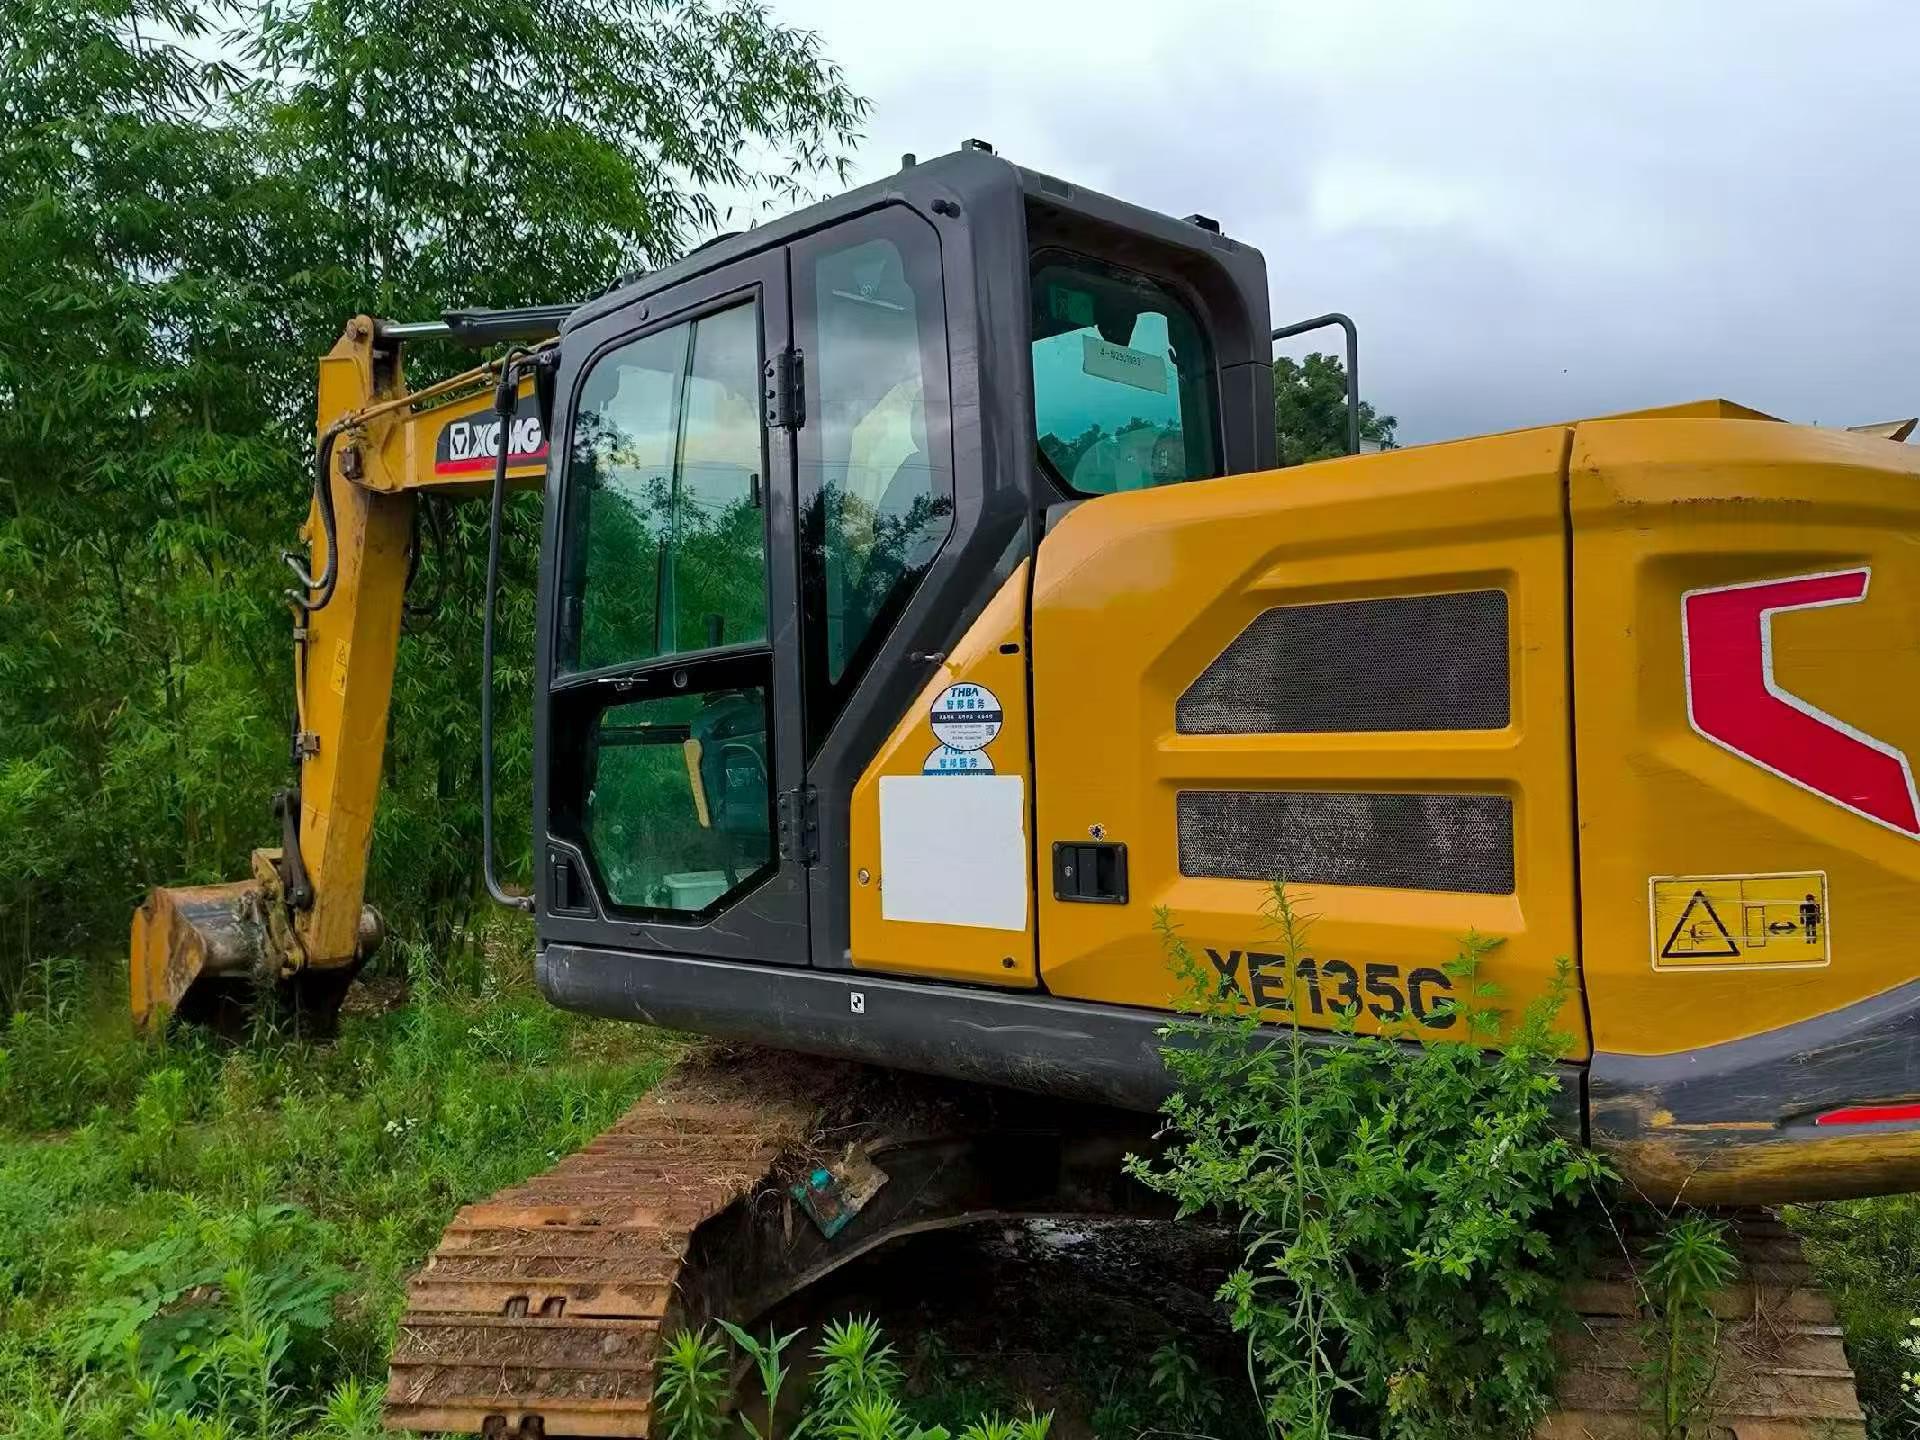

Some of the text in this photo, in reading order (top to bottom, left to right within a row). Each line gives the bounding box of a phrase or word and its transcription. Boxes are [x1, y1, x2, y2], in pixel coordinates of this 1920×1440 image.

[469, 417, 542, 459] XCMG
[951, 687, 979, 697] THBA
[1204, 947, 1457, 1029] XE135G
